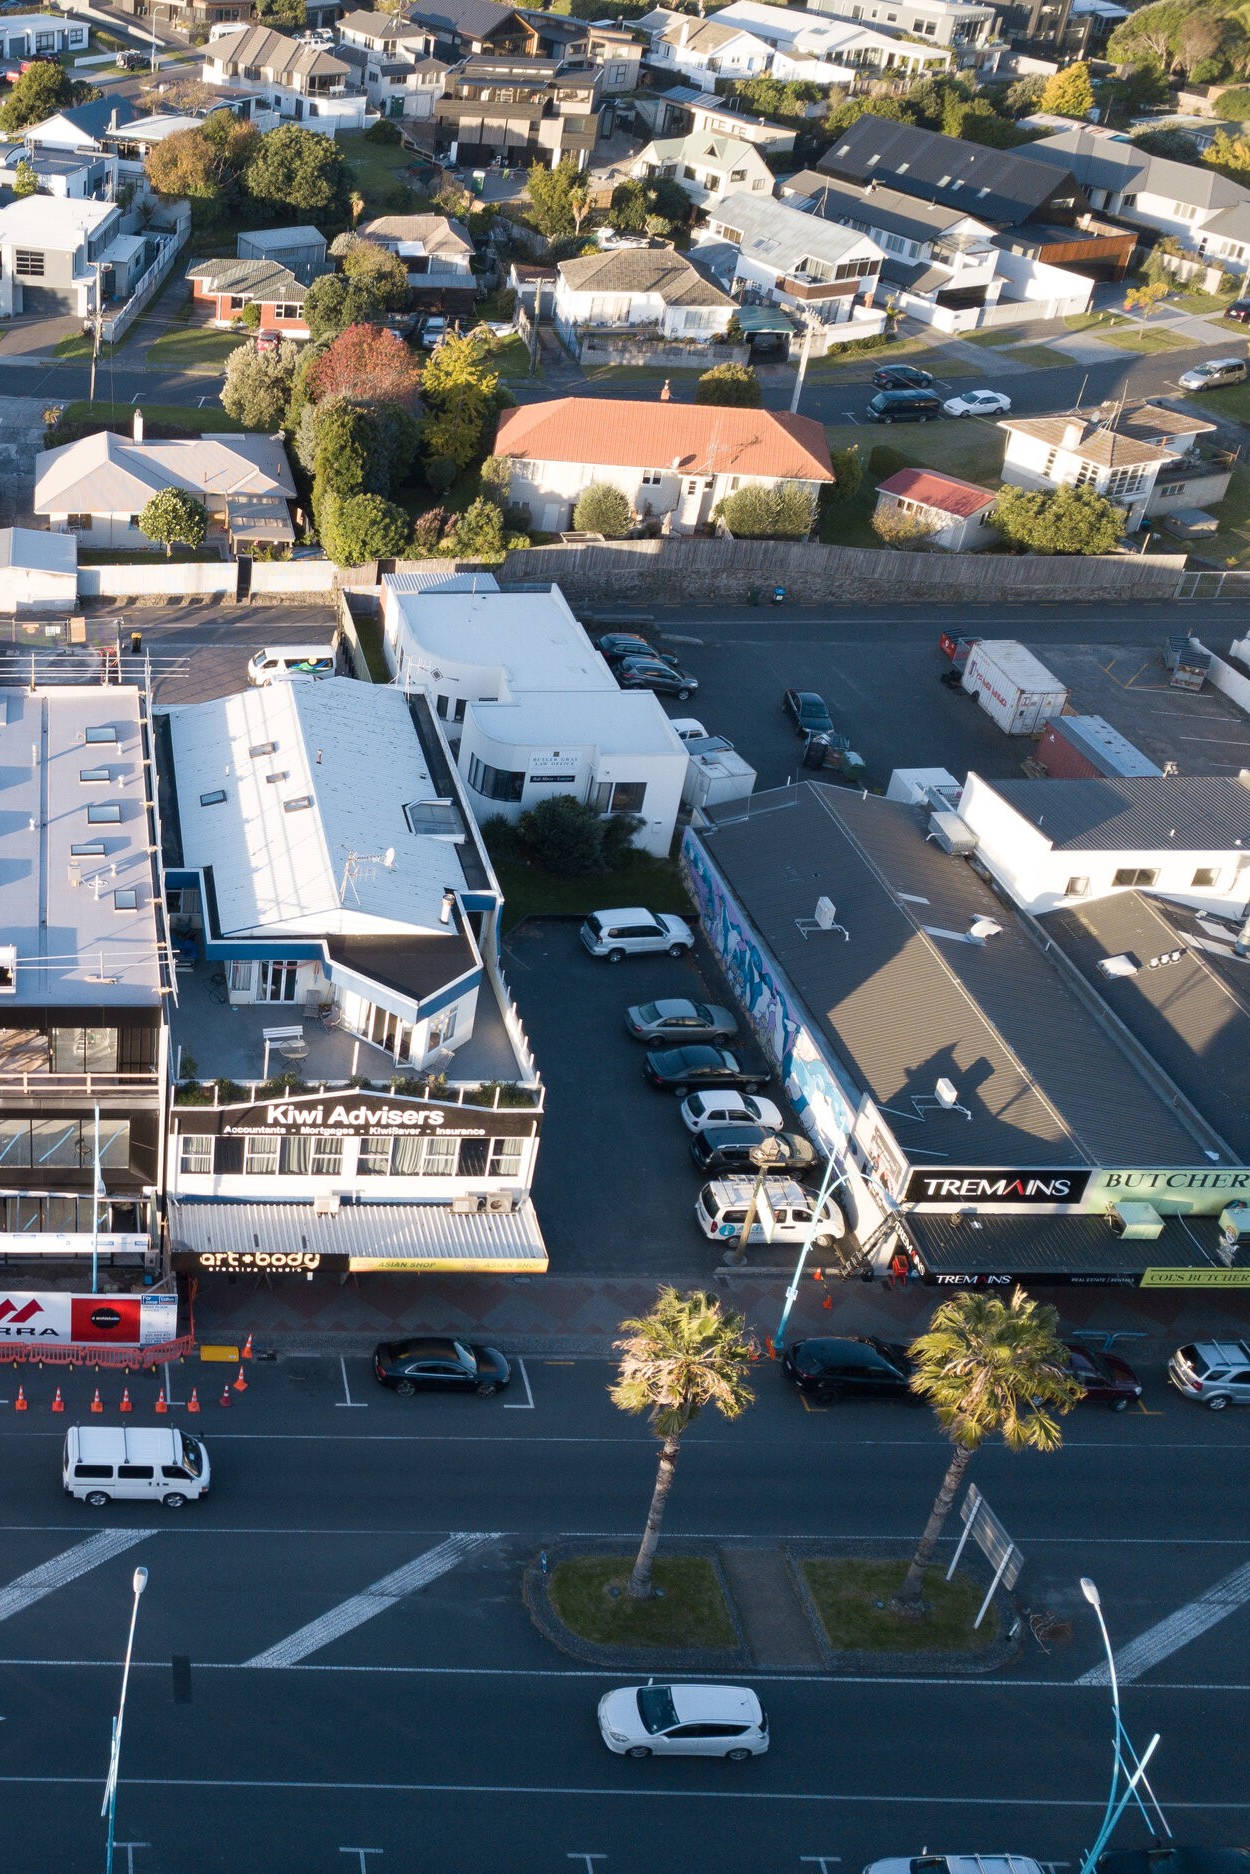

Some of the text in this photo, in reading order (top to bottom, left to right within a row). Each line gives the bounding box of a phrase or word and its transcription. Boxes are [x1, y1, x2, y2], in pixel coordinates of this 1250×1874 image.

[266, 1106, 444, 1125] Kiwi Advisers
[224, 1126, 286, 1134] Accountants
[300, 1126, 354, 1136] Mortgages
[370, 1126, 421, 1135] KiwiSaver
[436, 1127, 486, 1136] Insurance
[924, 1179, 1070, 1196] TREMAINS
[1104, 1173, 1250, 1188] BUTCHER
[936, 1275, 1012, 1284] TREMAINS
